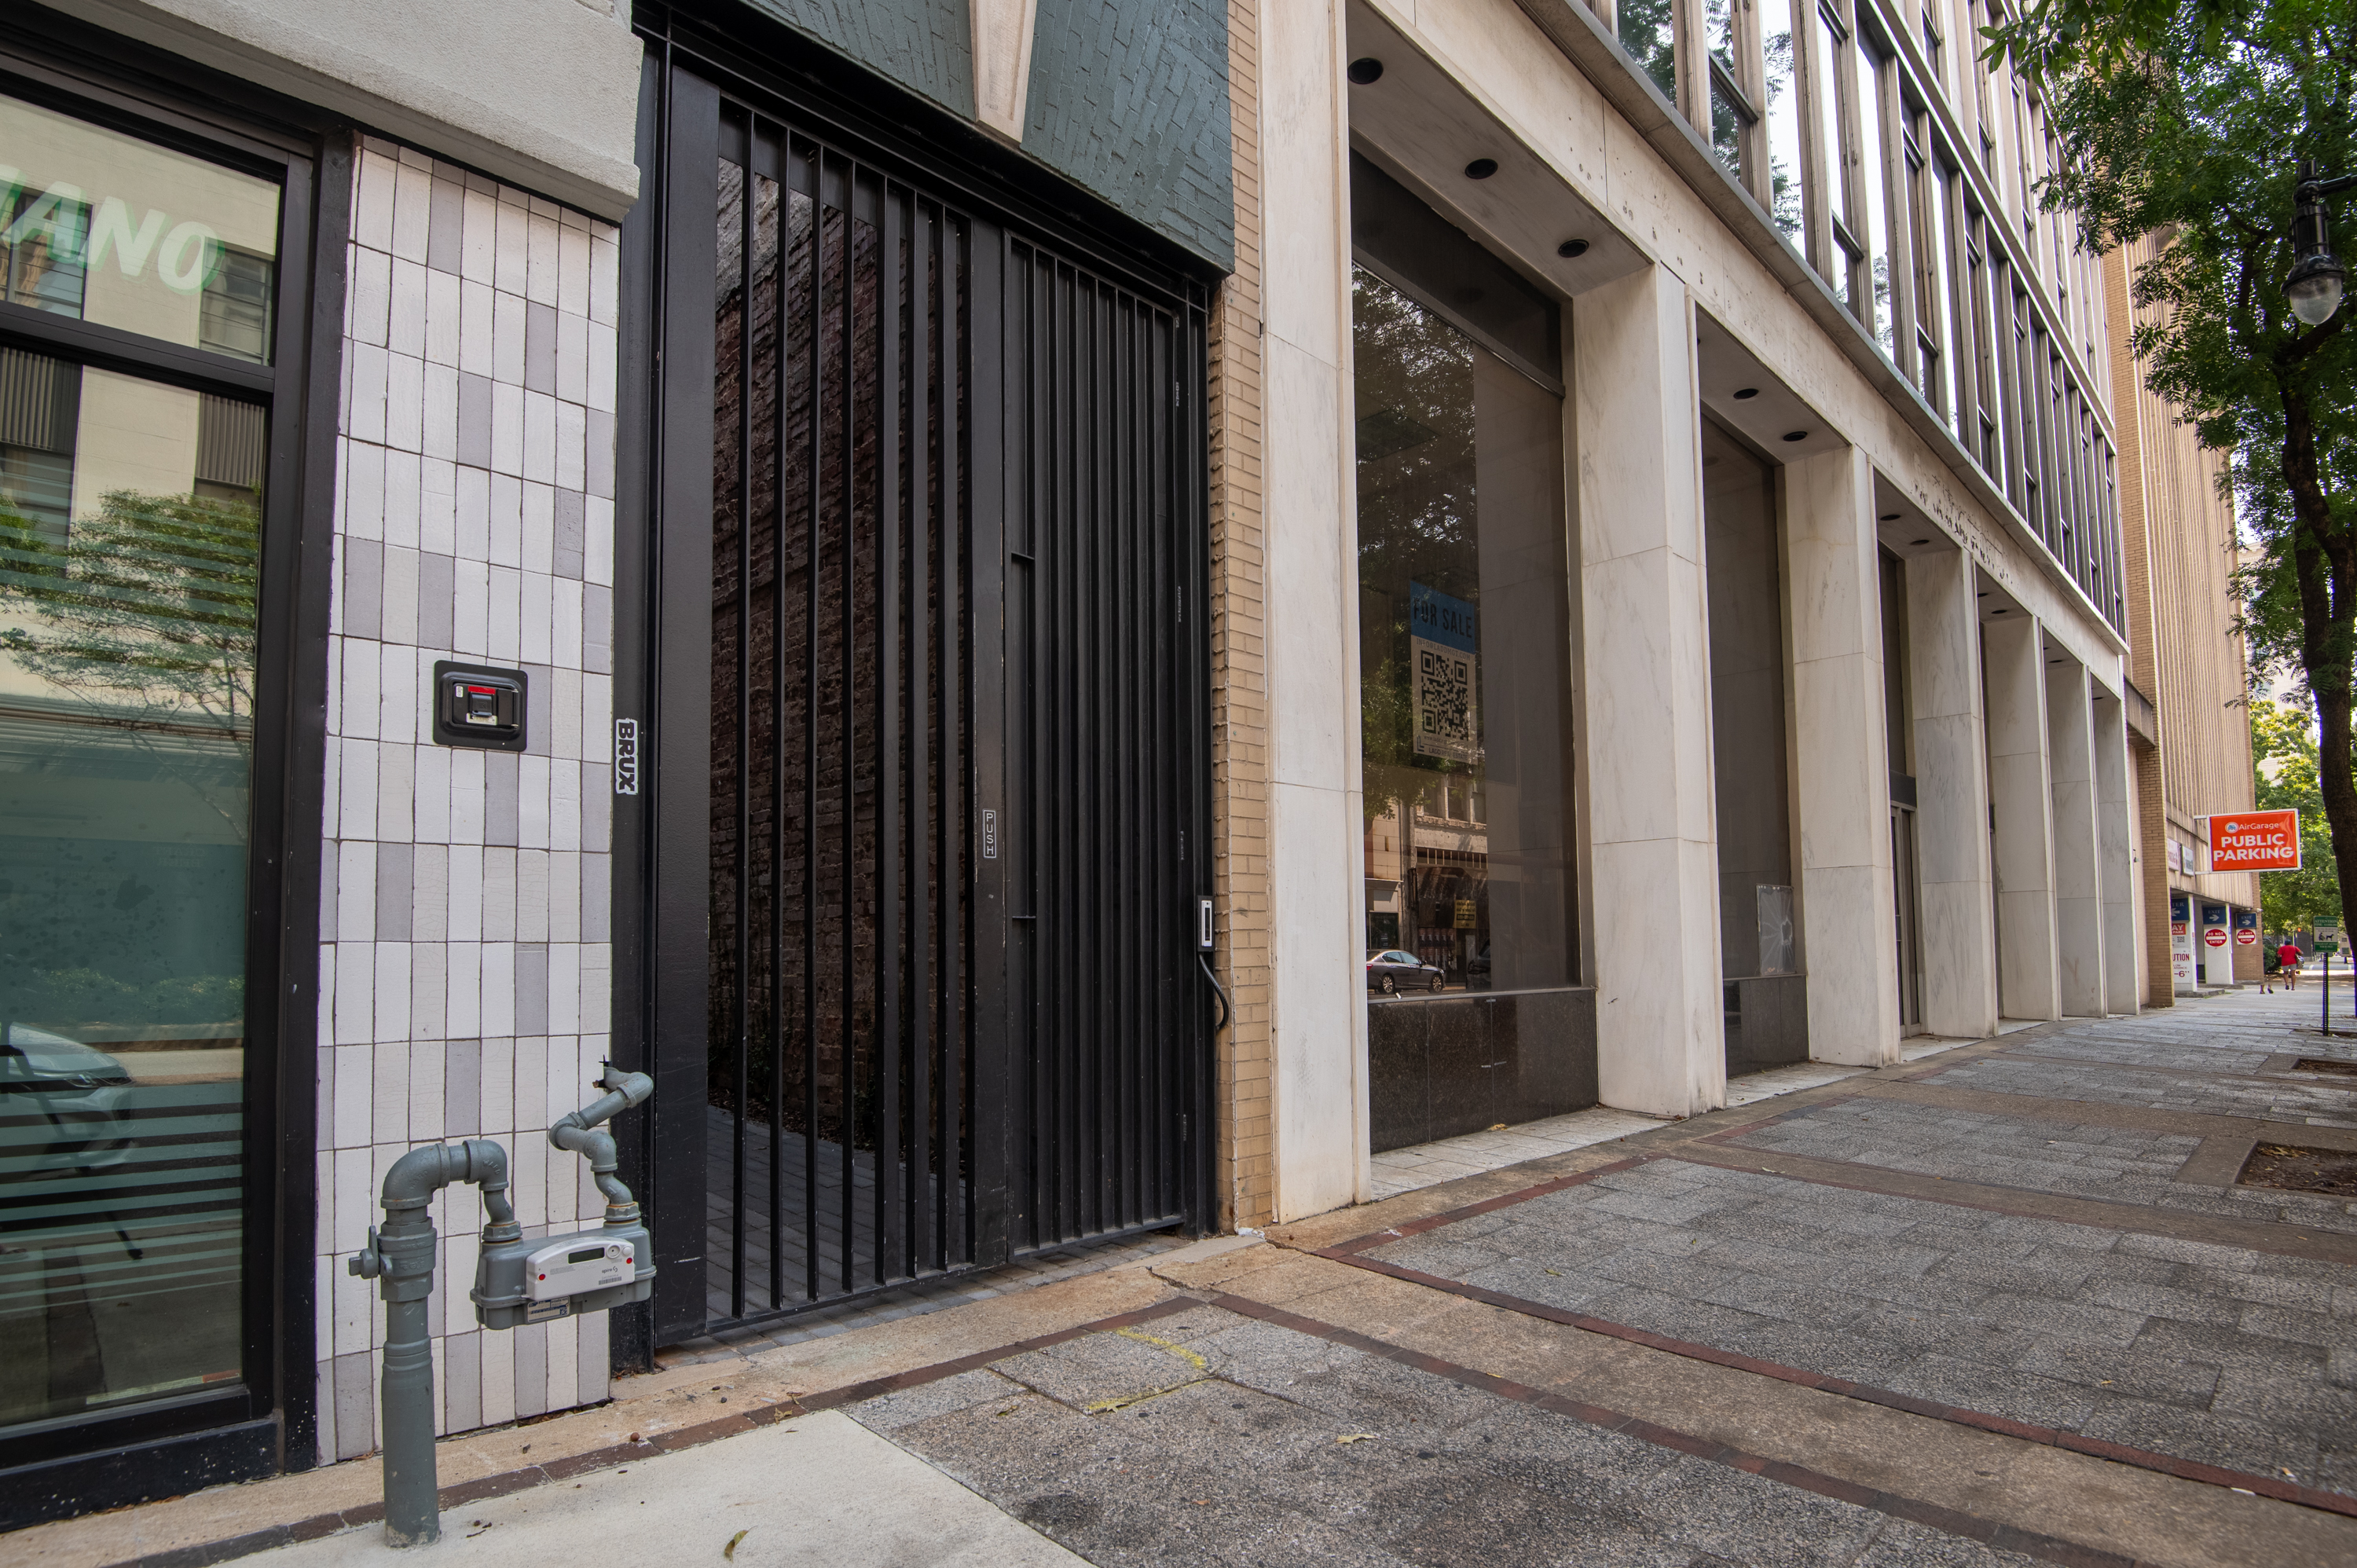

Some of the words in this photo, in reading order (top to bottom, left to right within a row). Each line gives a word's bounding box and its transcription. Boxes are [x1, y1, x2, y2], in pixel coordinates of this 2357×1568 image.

[1413, 598, 1437, 627] FOR
[1442, 608, 1472, 638] SALE
[1417, 638, 1471, 661] INFO@LADDMGT.COM
[618, 720, 636, 793] BRUX
[2221, 833, 2285, 848] PUBLIC
[2213, 847, 2294, 862] PARKING
